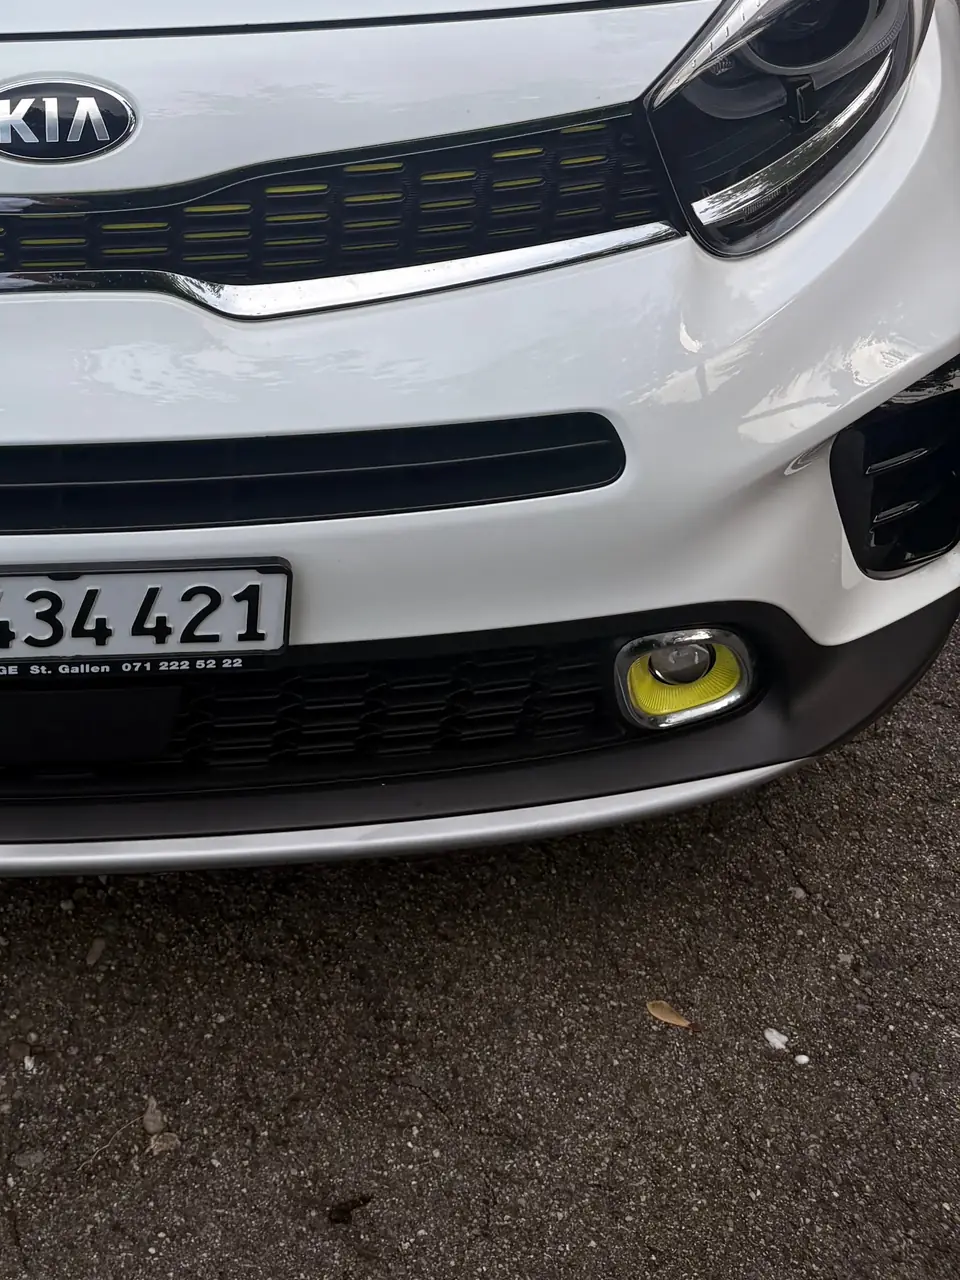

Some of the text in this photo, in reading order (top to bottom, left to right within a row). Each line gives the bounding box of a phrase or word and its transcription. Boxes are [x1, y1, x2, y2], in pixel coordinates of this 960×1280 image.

[130, 582, 267, 645] 421
[29, 664, 53, 675] St.
[57, 663, 111, 674] Gallen
[121, 661, 152, 672] 071
[158, 660, 190, 670] 222
[195, 659, 217, 669] 52
[222, 658, 243, 668] 22
